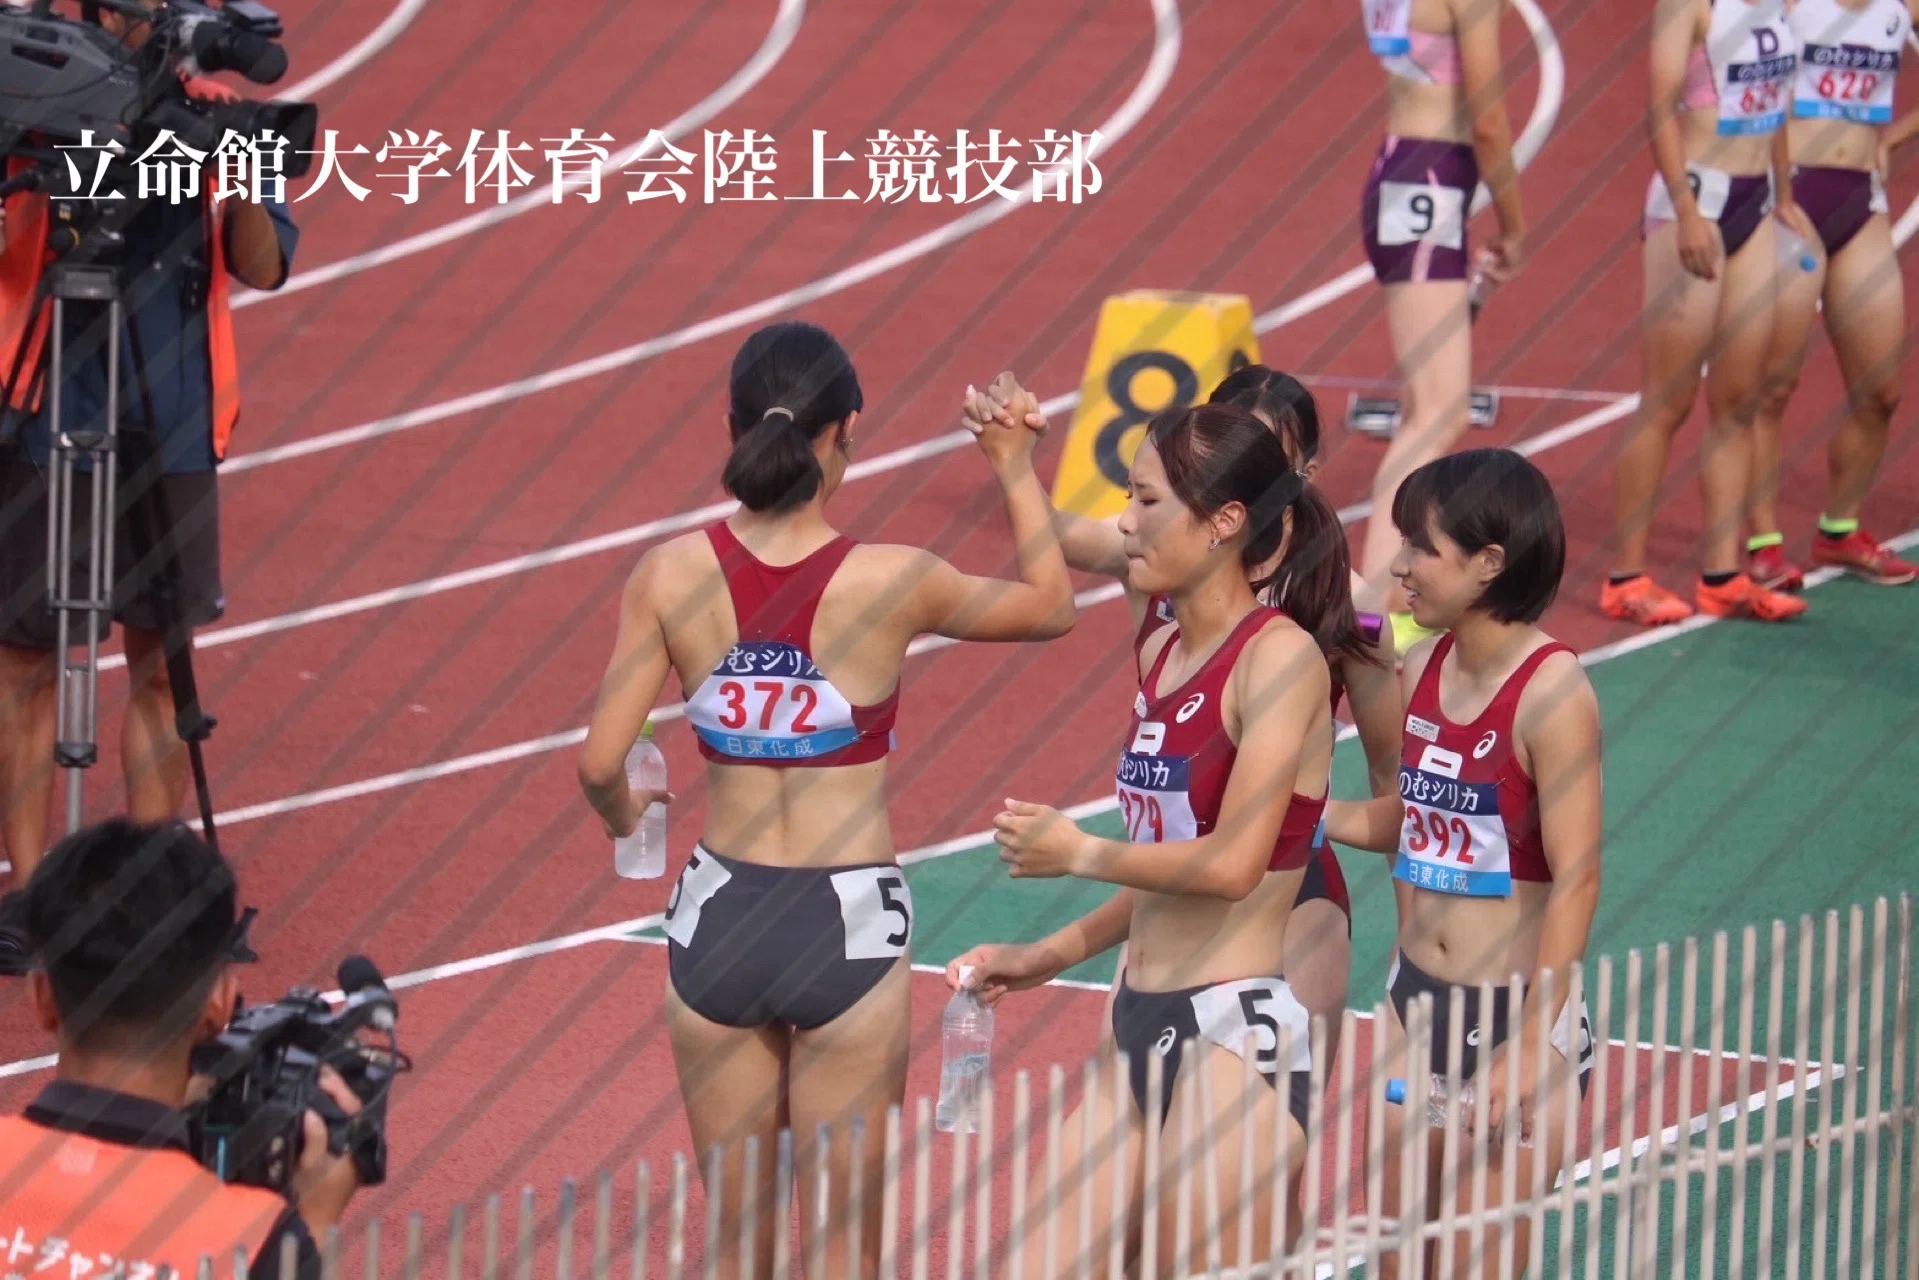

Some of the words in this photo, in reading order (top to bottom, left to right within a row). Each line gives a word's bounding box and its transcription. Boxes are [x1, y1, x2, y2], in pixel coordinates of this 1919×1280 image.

[1410, 194, 1434, 235] 9
[714, 646, 824, 676] むシリ
[718, 681, 817, 733] 372
[726, 736, 814, 756] 日東化成
[1400, 771, 1479, 812] のむシリカ
[1406, 805, 1475, 865] 392
[1409, 862, 1469, 892] 日東化成
[876, 877, 909, 947] 5
[1238, 988, 1278, 1062] 5
